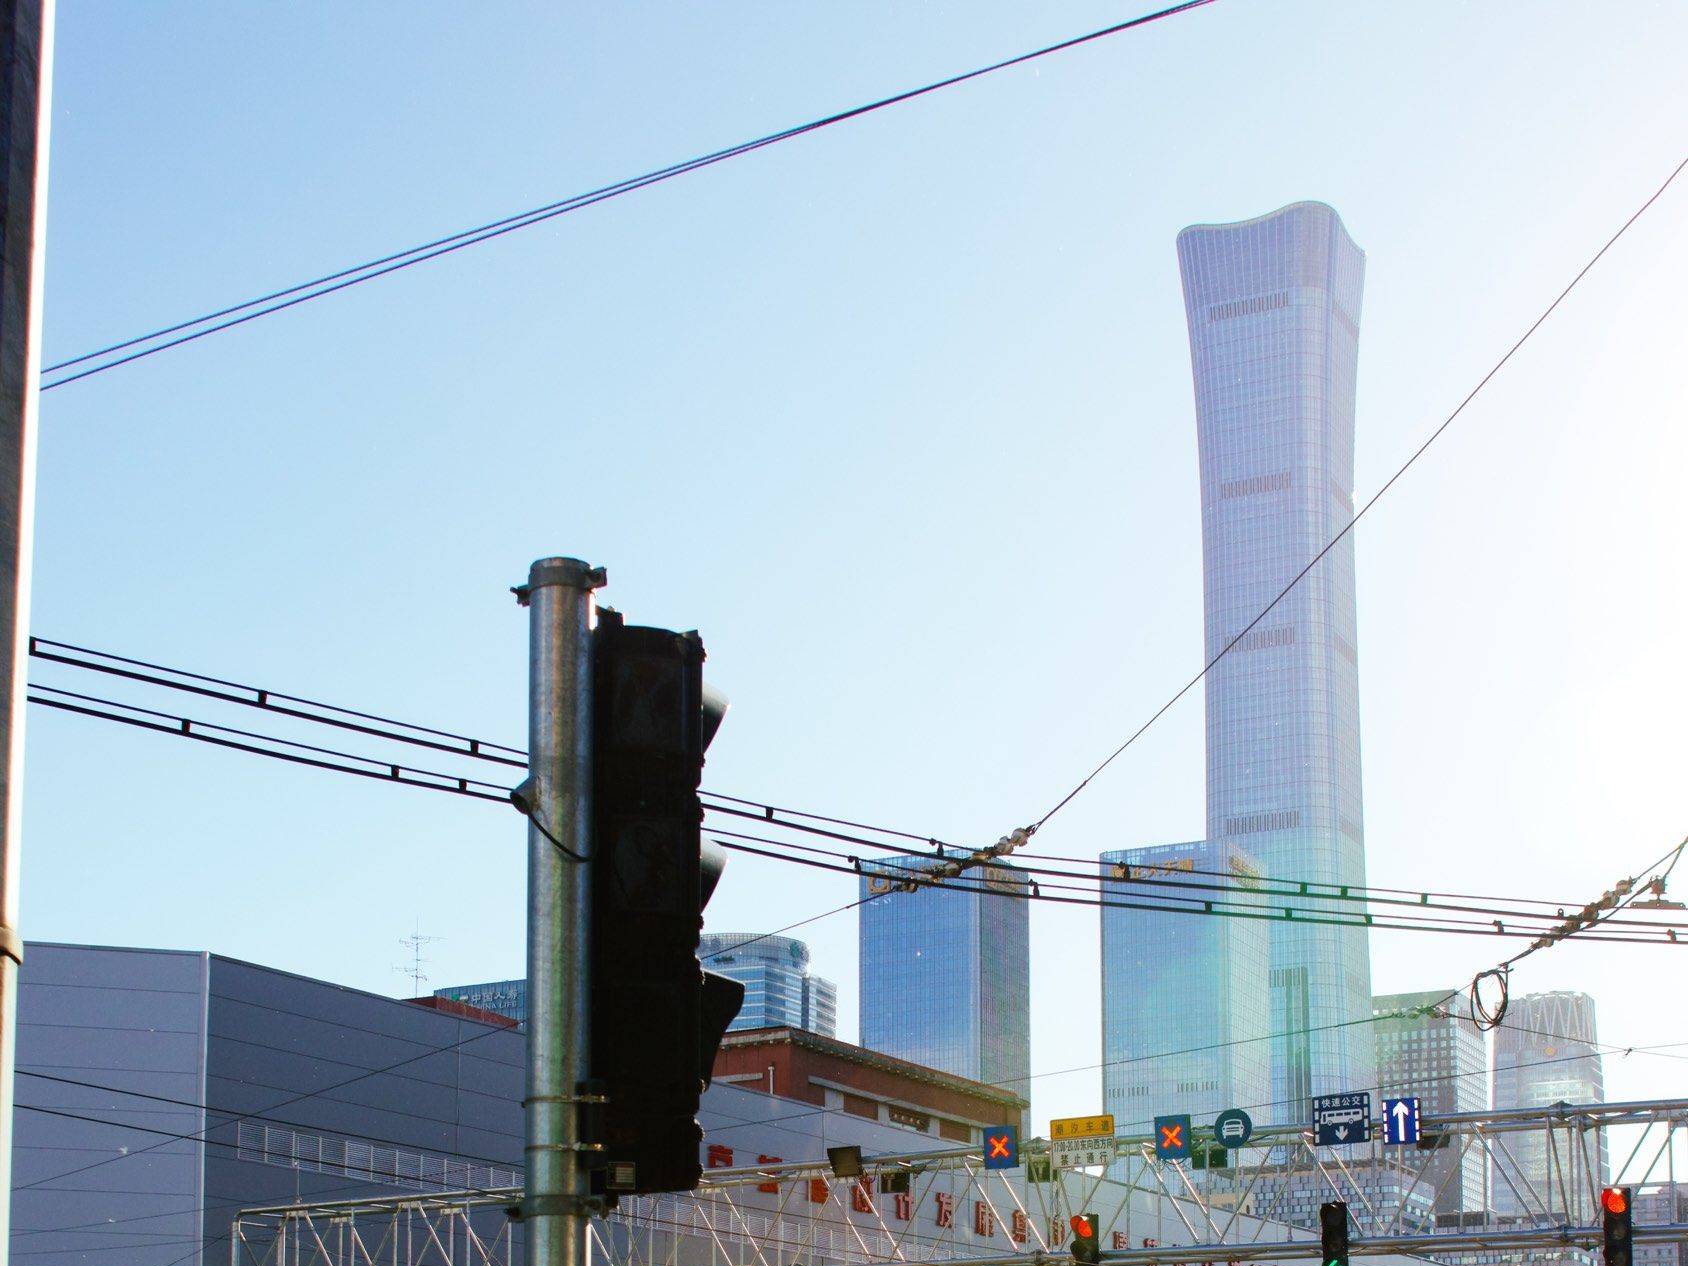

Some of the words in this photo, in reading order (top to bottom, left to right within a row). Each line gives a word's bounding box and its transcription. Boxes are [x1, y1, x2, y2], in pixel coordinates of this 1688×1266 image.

[472, 990, 518, 1004] 中国人寿
[1321, 1096, 1361, 1108] 快速公交
[1055, 1119, 1110, 1135] 潮汐车道
[1061, 1151, 1109, 1166] 禁止通行
